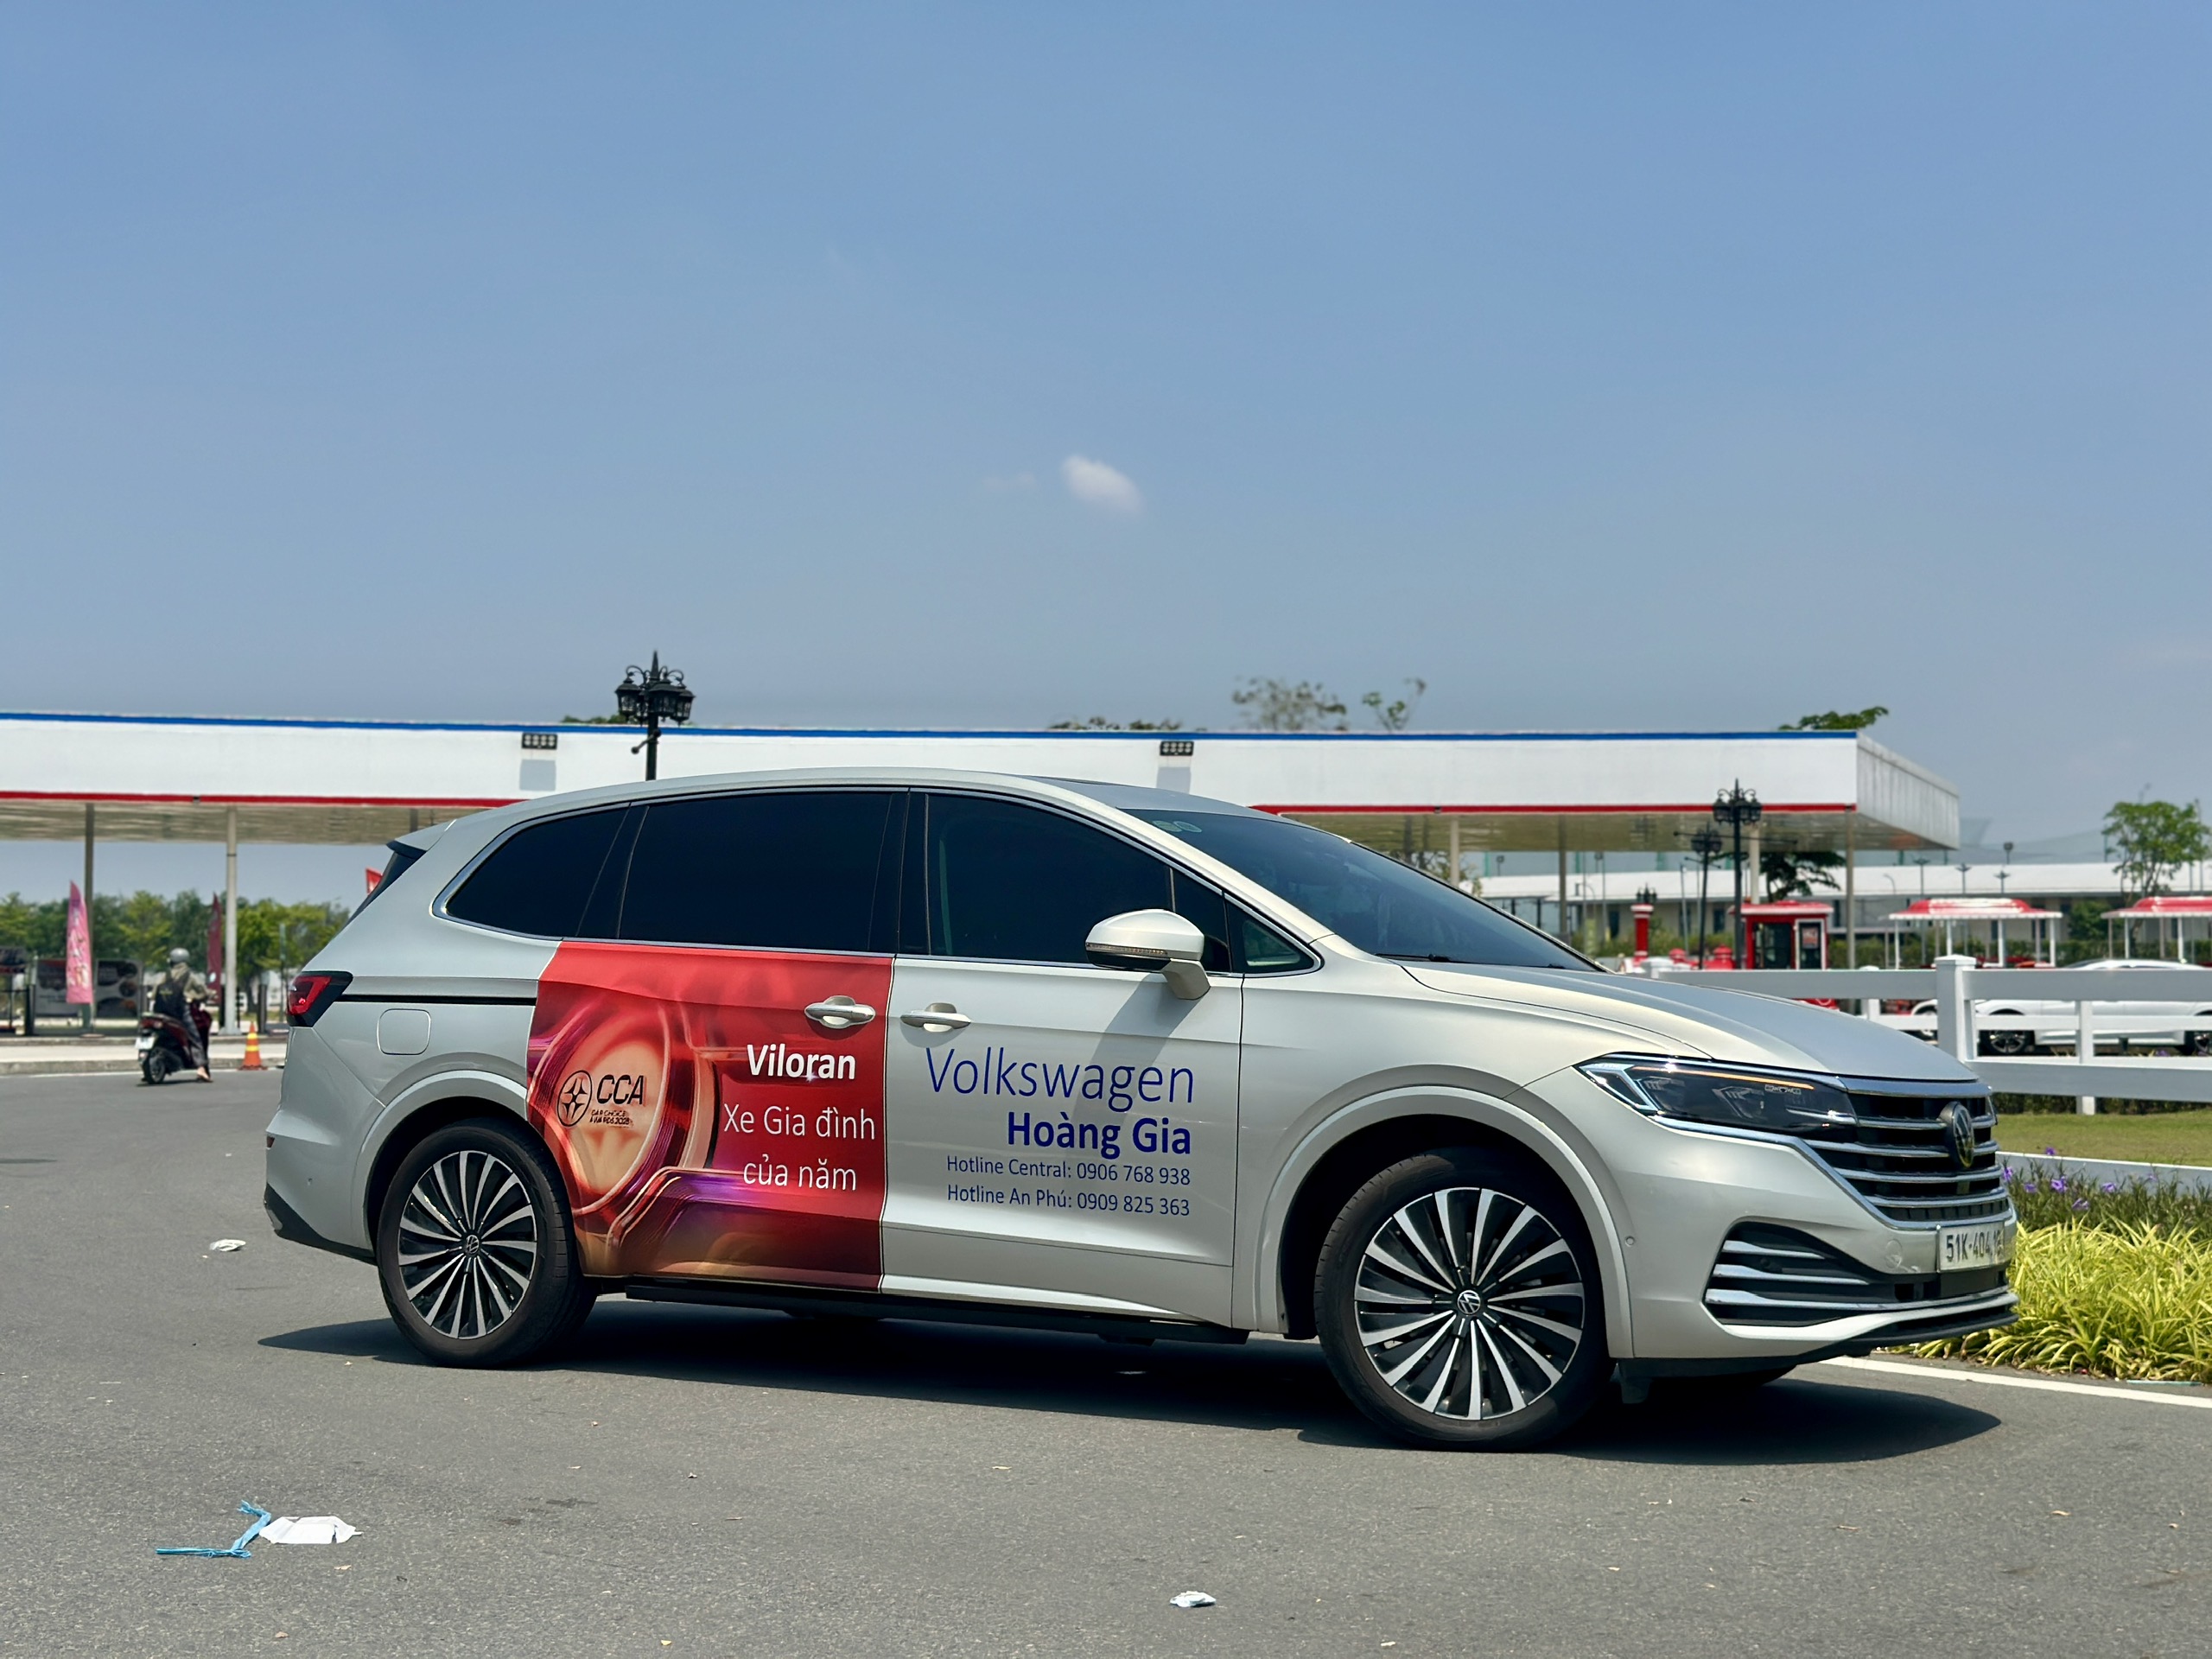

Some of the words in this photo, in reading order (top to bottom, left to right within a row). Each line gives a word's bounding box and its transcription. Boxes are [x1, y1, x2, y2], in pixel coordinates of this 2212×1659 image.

[747, 1043, 856, 1081] Viloran
[926, 1046, 1195, 1113] Volkswagen
[597, 1075, 645, 1104] CCA
[723, 1103, 754, 1134] Xe
[764, 1105, 806, 1136] Gia
[816, 1107, 875, 1140] đình
[1007, 1111, 1121, 1160] Hoàng
[1132, 1117, 1191, 1154] Gia
[742, 1154, 788, 1186] của
[798, 1158, 857, 1191] năm
[947, 1155, 1003, 1174] Hotline
[1008, 1159, 1071, 1179] Central:
[1077, 1162, 1118, 1181] 0906
[1123, 1165, 1154, 1183] 768
[1159, 1167, 1191, 1185] 938
[948, 1184, 1005, 1204] Hotline
[1009, 1187, 1031, 1205] An
[1036, 1189, 1072, 1208] Phú:
[1077, 1192, 1118, 1211] 0909
[1123, 1195, 1154, 1213] 825
[1159, 1198, 1190, 1216] 363
